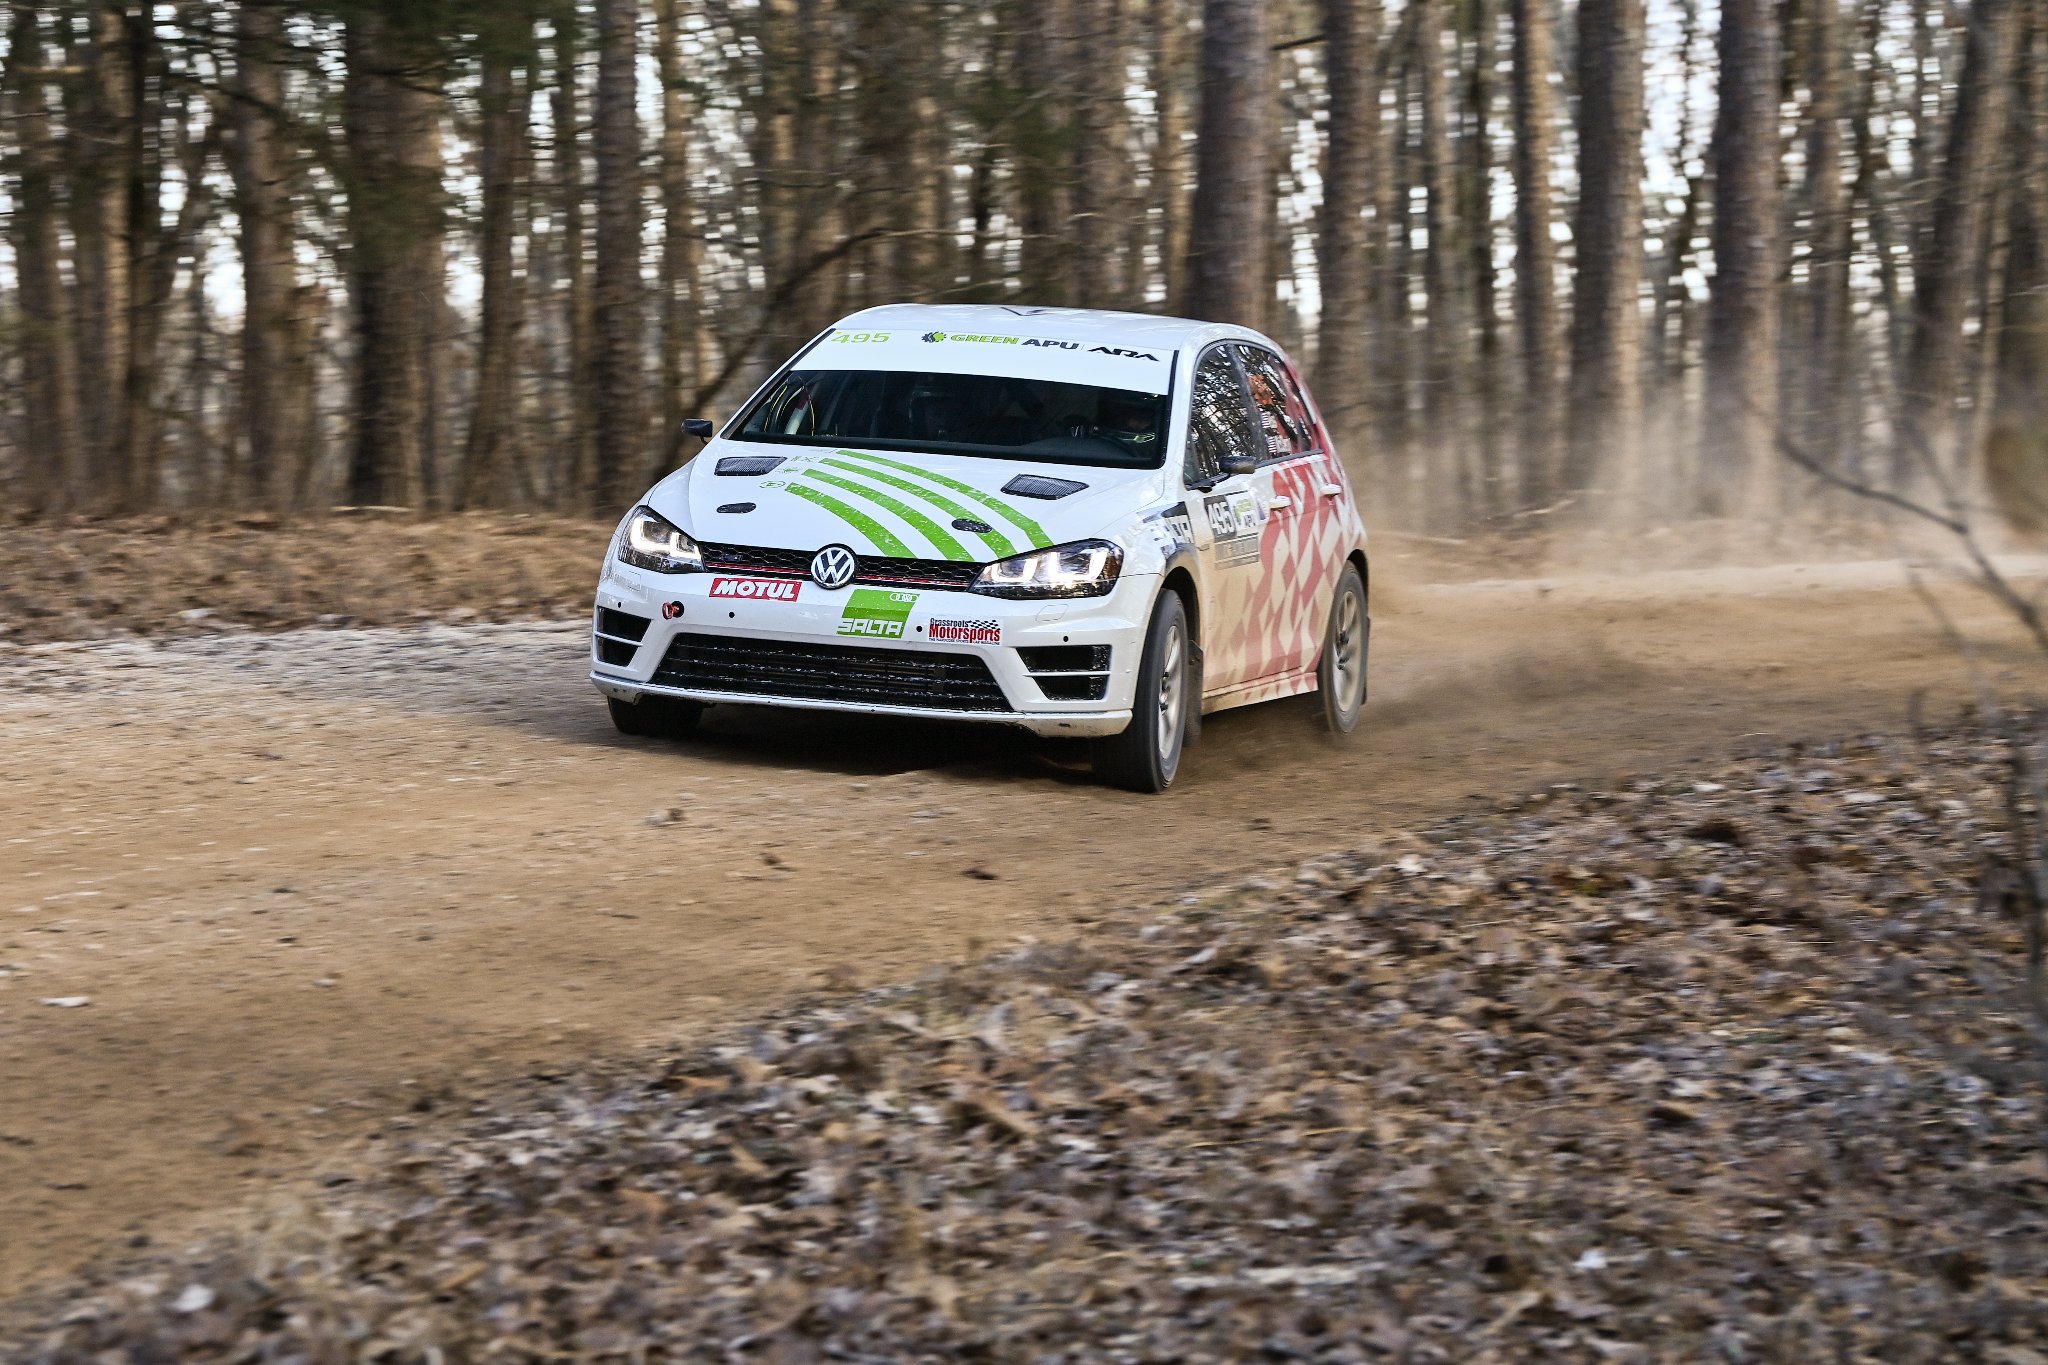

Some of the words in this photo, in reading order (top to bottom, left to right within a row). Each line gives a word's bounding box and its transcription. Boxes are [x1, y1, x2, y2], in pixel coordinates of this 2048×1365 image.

[831, 332, 891, 344] 495
[950, 334, 1019, 345] GREEN
[1021, 338, 1079, 350] APU
[1207, 502, 1235, 535] 495
[713, 580, 795, 598] MOTUL
[837, 618, 903, 636] SALTA
[930, 617, 969, 628] Grassroots
[928, 623, 1001, 643] Motorsports
